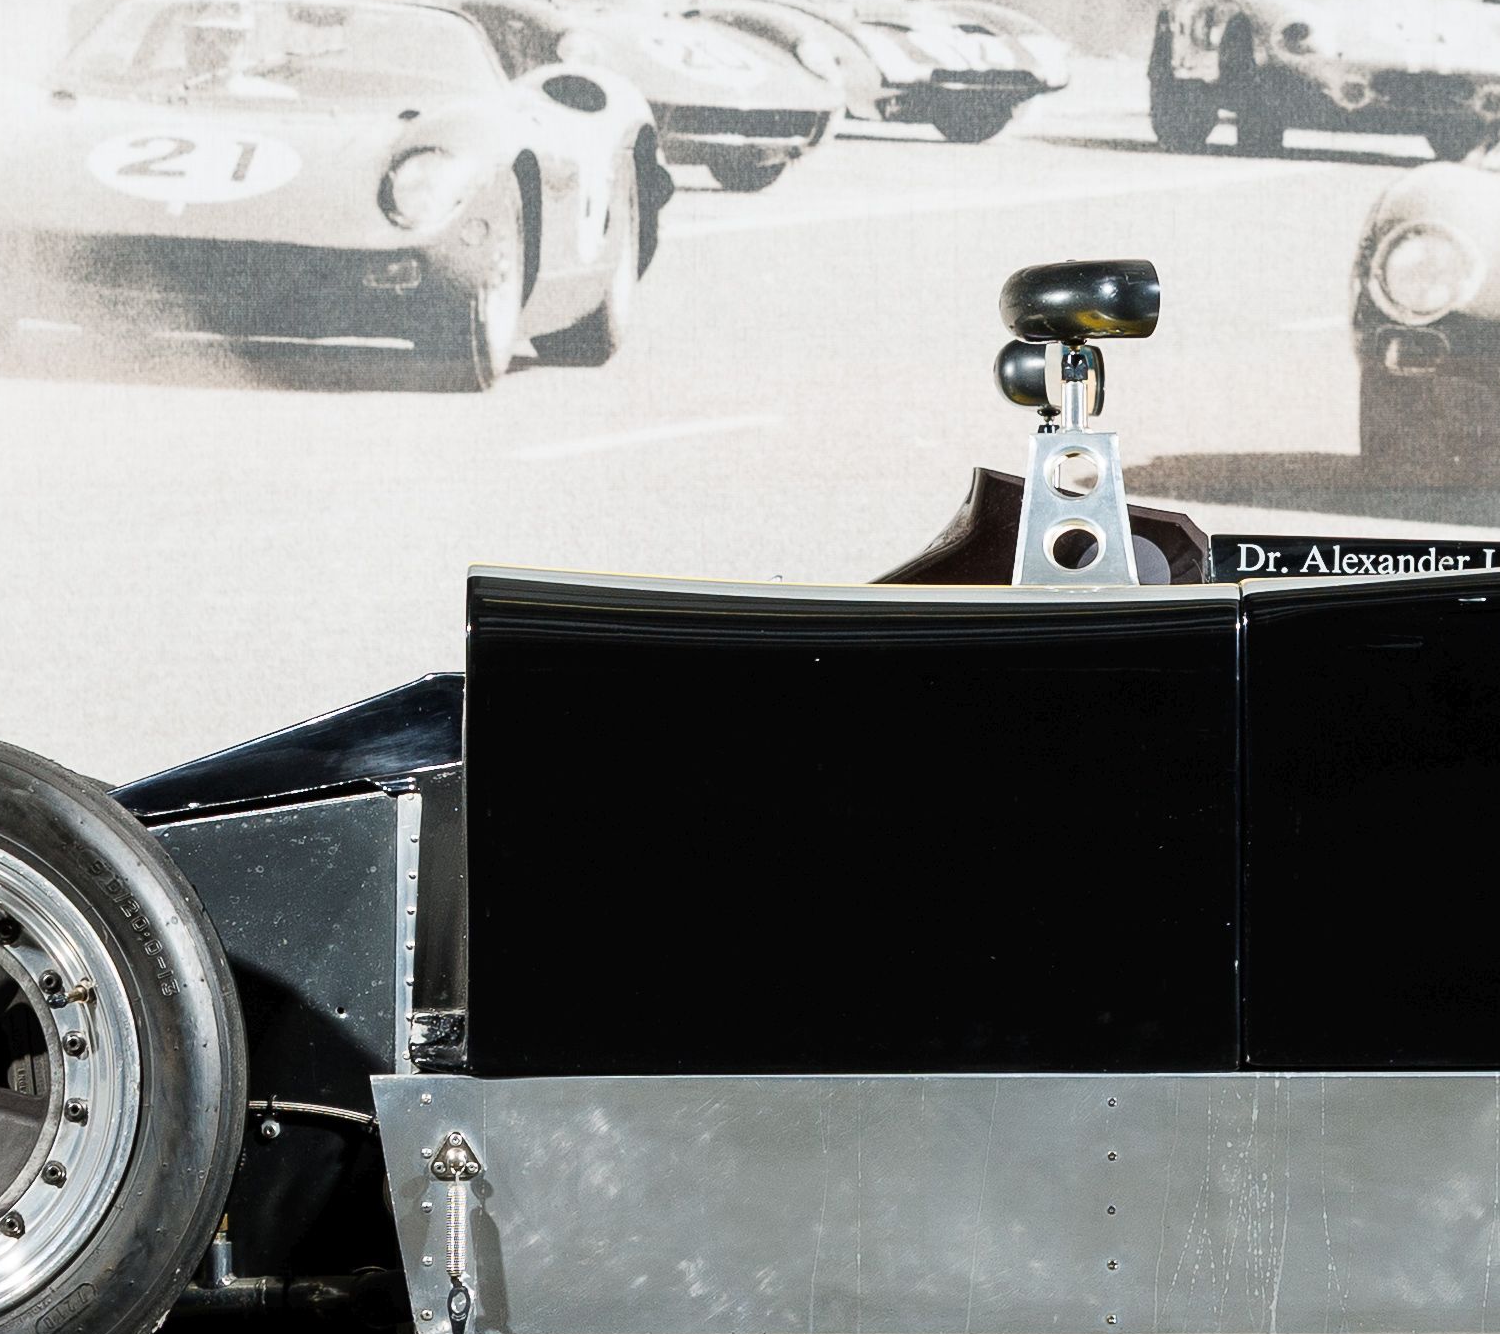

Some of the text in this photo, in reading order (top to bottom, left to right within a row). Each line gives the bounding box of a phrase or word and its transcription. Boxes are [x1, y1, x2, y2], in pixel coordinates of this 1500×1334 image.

[116, 135, 257, 181] 21
[1237, 544, 1288, 573] Dr.
[1300, 545, 1470, 575] Alexander
